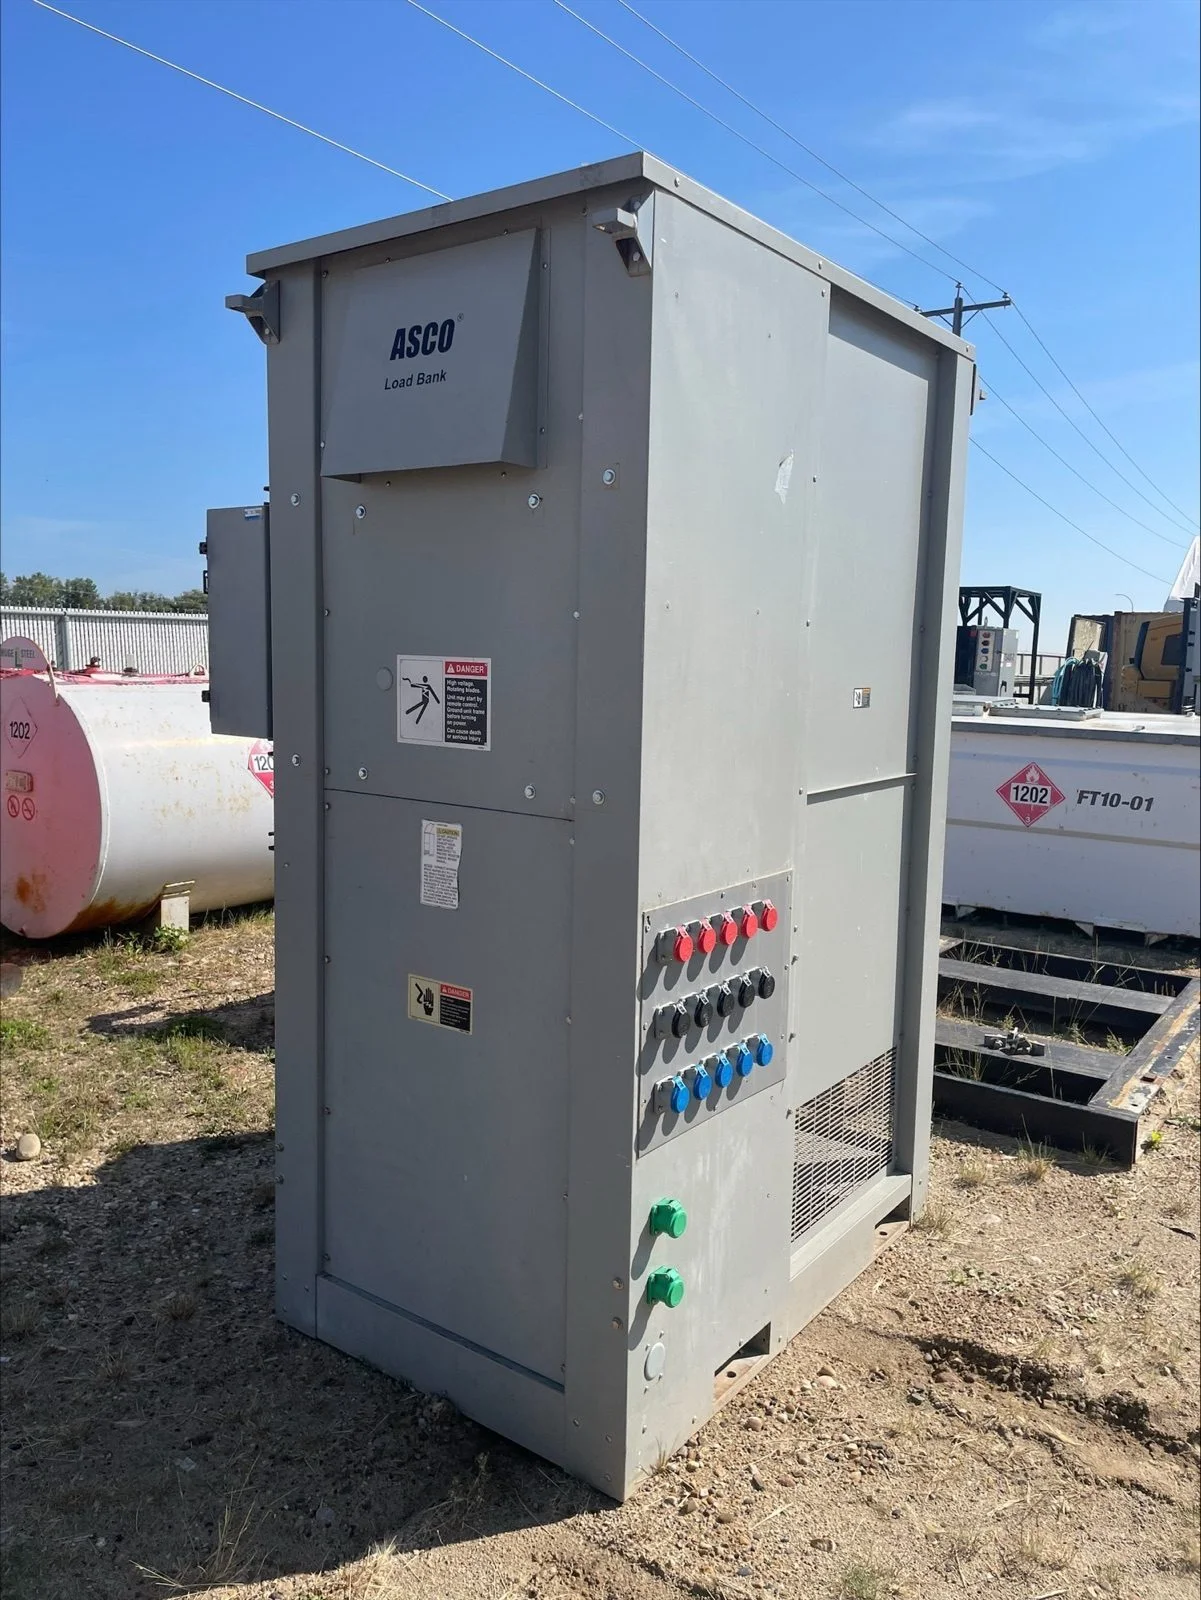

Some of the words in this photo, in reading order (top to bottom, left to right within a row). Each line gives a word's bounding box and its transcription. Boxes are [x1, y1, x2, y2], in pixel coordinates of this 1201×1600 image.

[390, 319, 455, 360] ASCO
[385, 374, 414, 390] Load
[417, 369, 447, 385] Bank
[456, 664, 484, 674] DANGER
[10, 721, 30, 740] 1202
[1013, 785, 1049, 804] 1202
[1077, 789, 1154, 812] FT10-01
